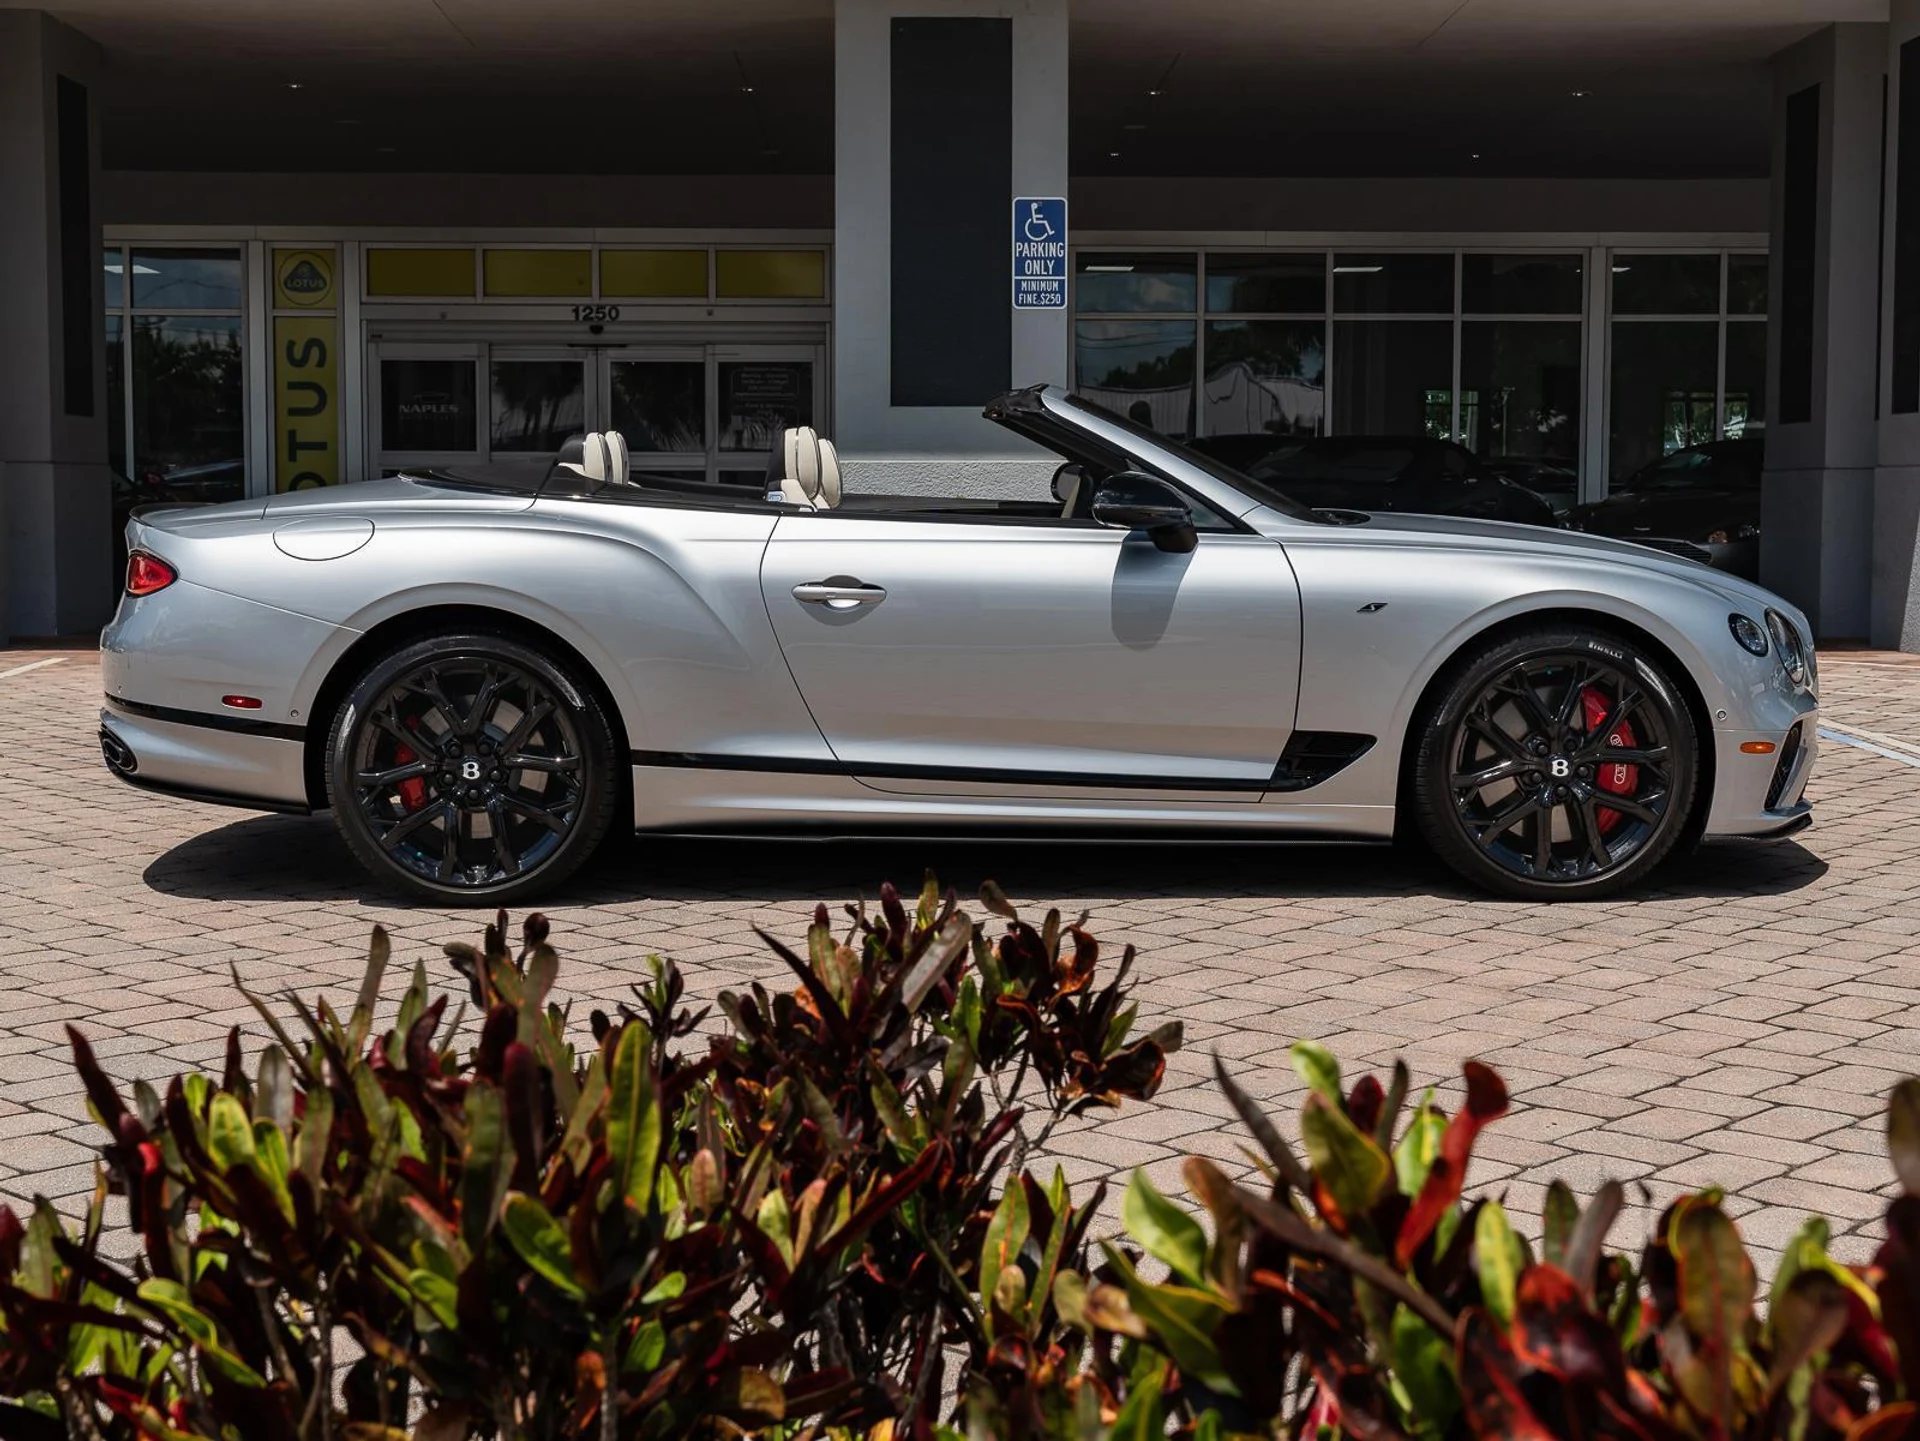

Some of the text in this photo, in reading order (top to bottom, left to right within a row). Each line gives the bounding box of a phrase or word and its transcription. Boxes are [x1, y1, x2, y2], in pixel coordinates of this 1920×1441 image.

[1016, 242, 1065, 257] PARKING
[1024, 259, 1055, 275] ONLY
[286, 278, 325, 288] LOTUS
[1021, 280, 1059, 291] MINIMUM
[1018, 293, 1061, 305] FINE $250
[572, 304, 620, 321] 1250
[286, 337, 328, 491] TUS
[398, 404, 460, 413] NAPLES
[1588, 641, 1624, 660] PIRELLI
[462, 761, 480, 780] B
[1551, 759, 1569, 777] B
